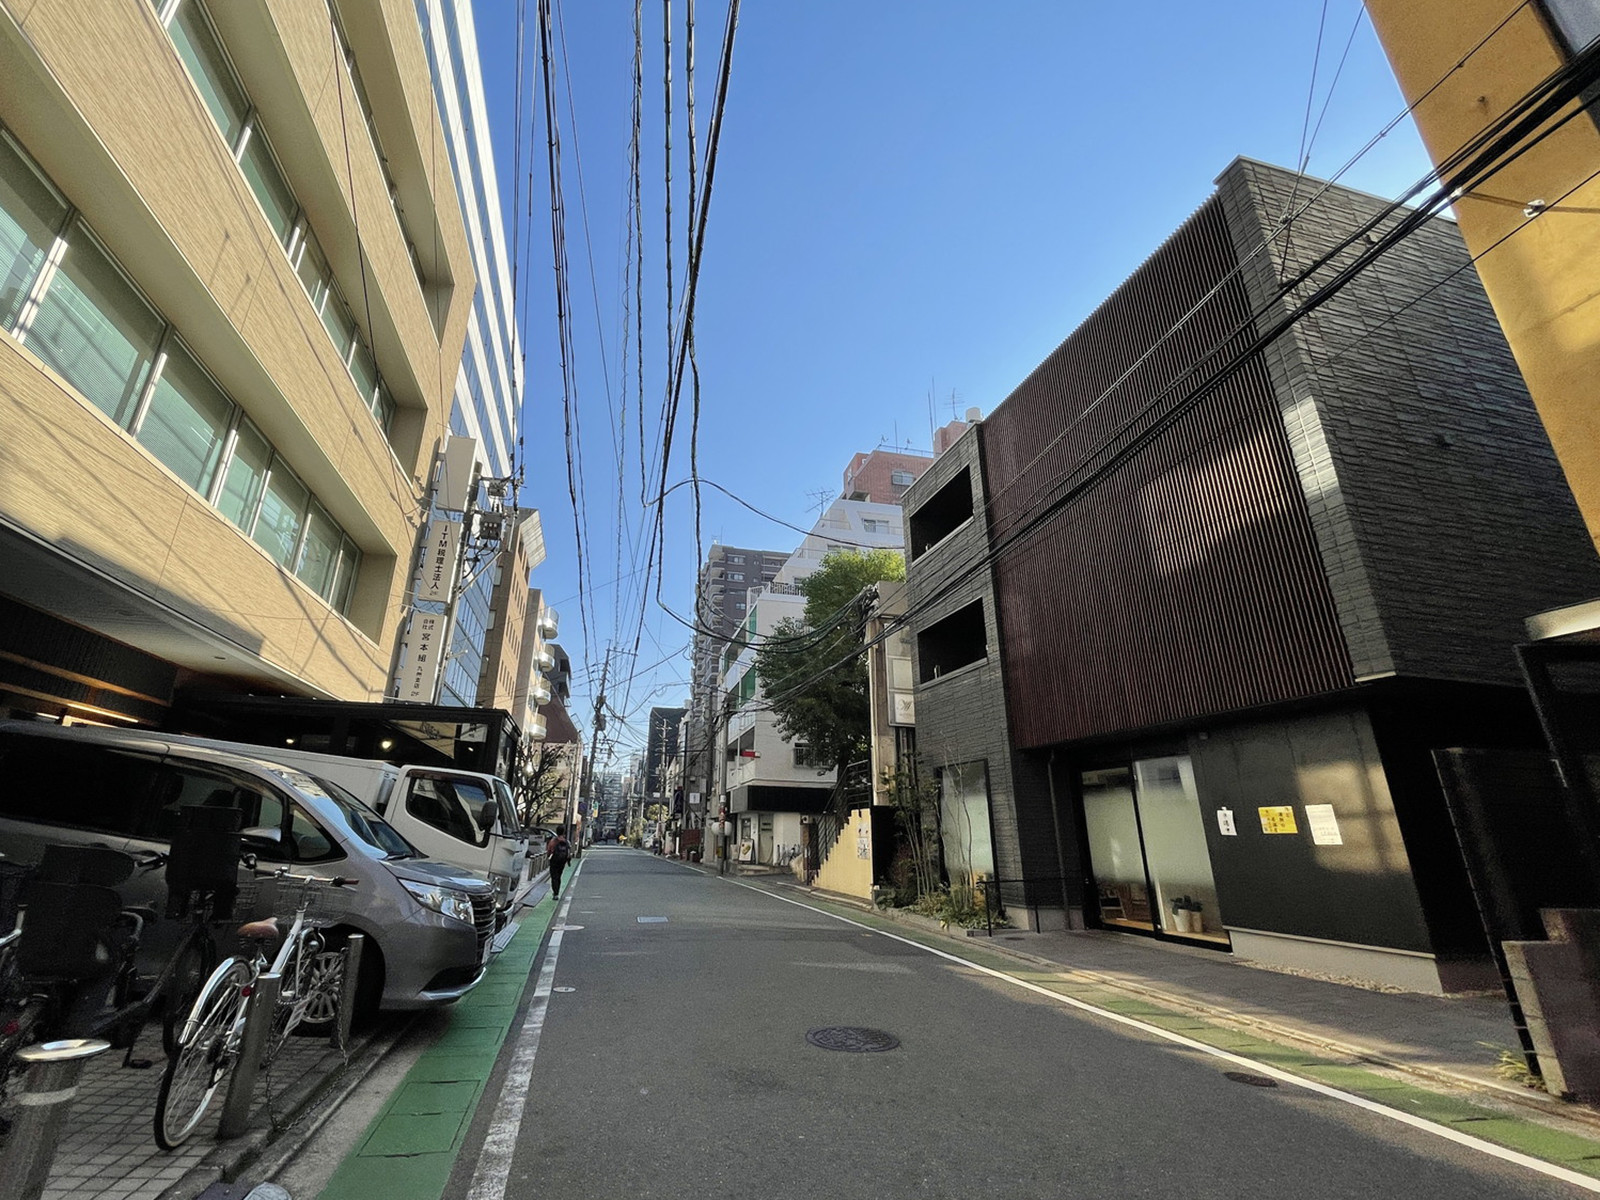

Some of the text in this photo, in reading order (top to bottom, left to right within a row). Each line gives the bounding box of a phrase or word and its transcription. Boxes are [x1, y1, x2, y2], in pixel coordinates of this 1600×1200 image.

[430, 524, 448, 590] ITM税理士法人
[417, 633, 431, 662] 宮本組
